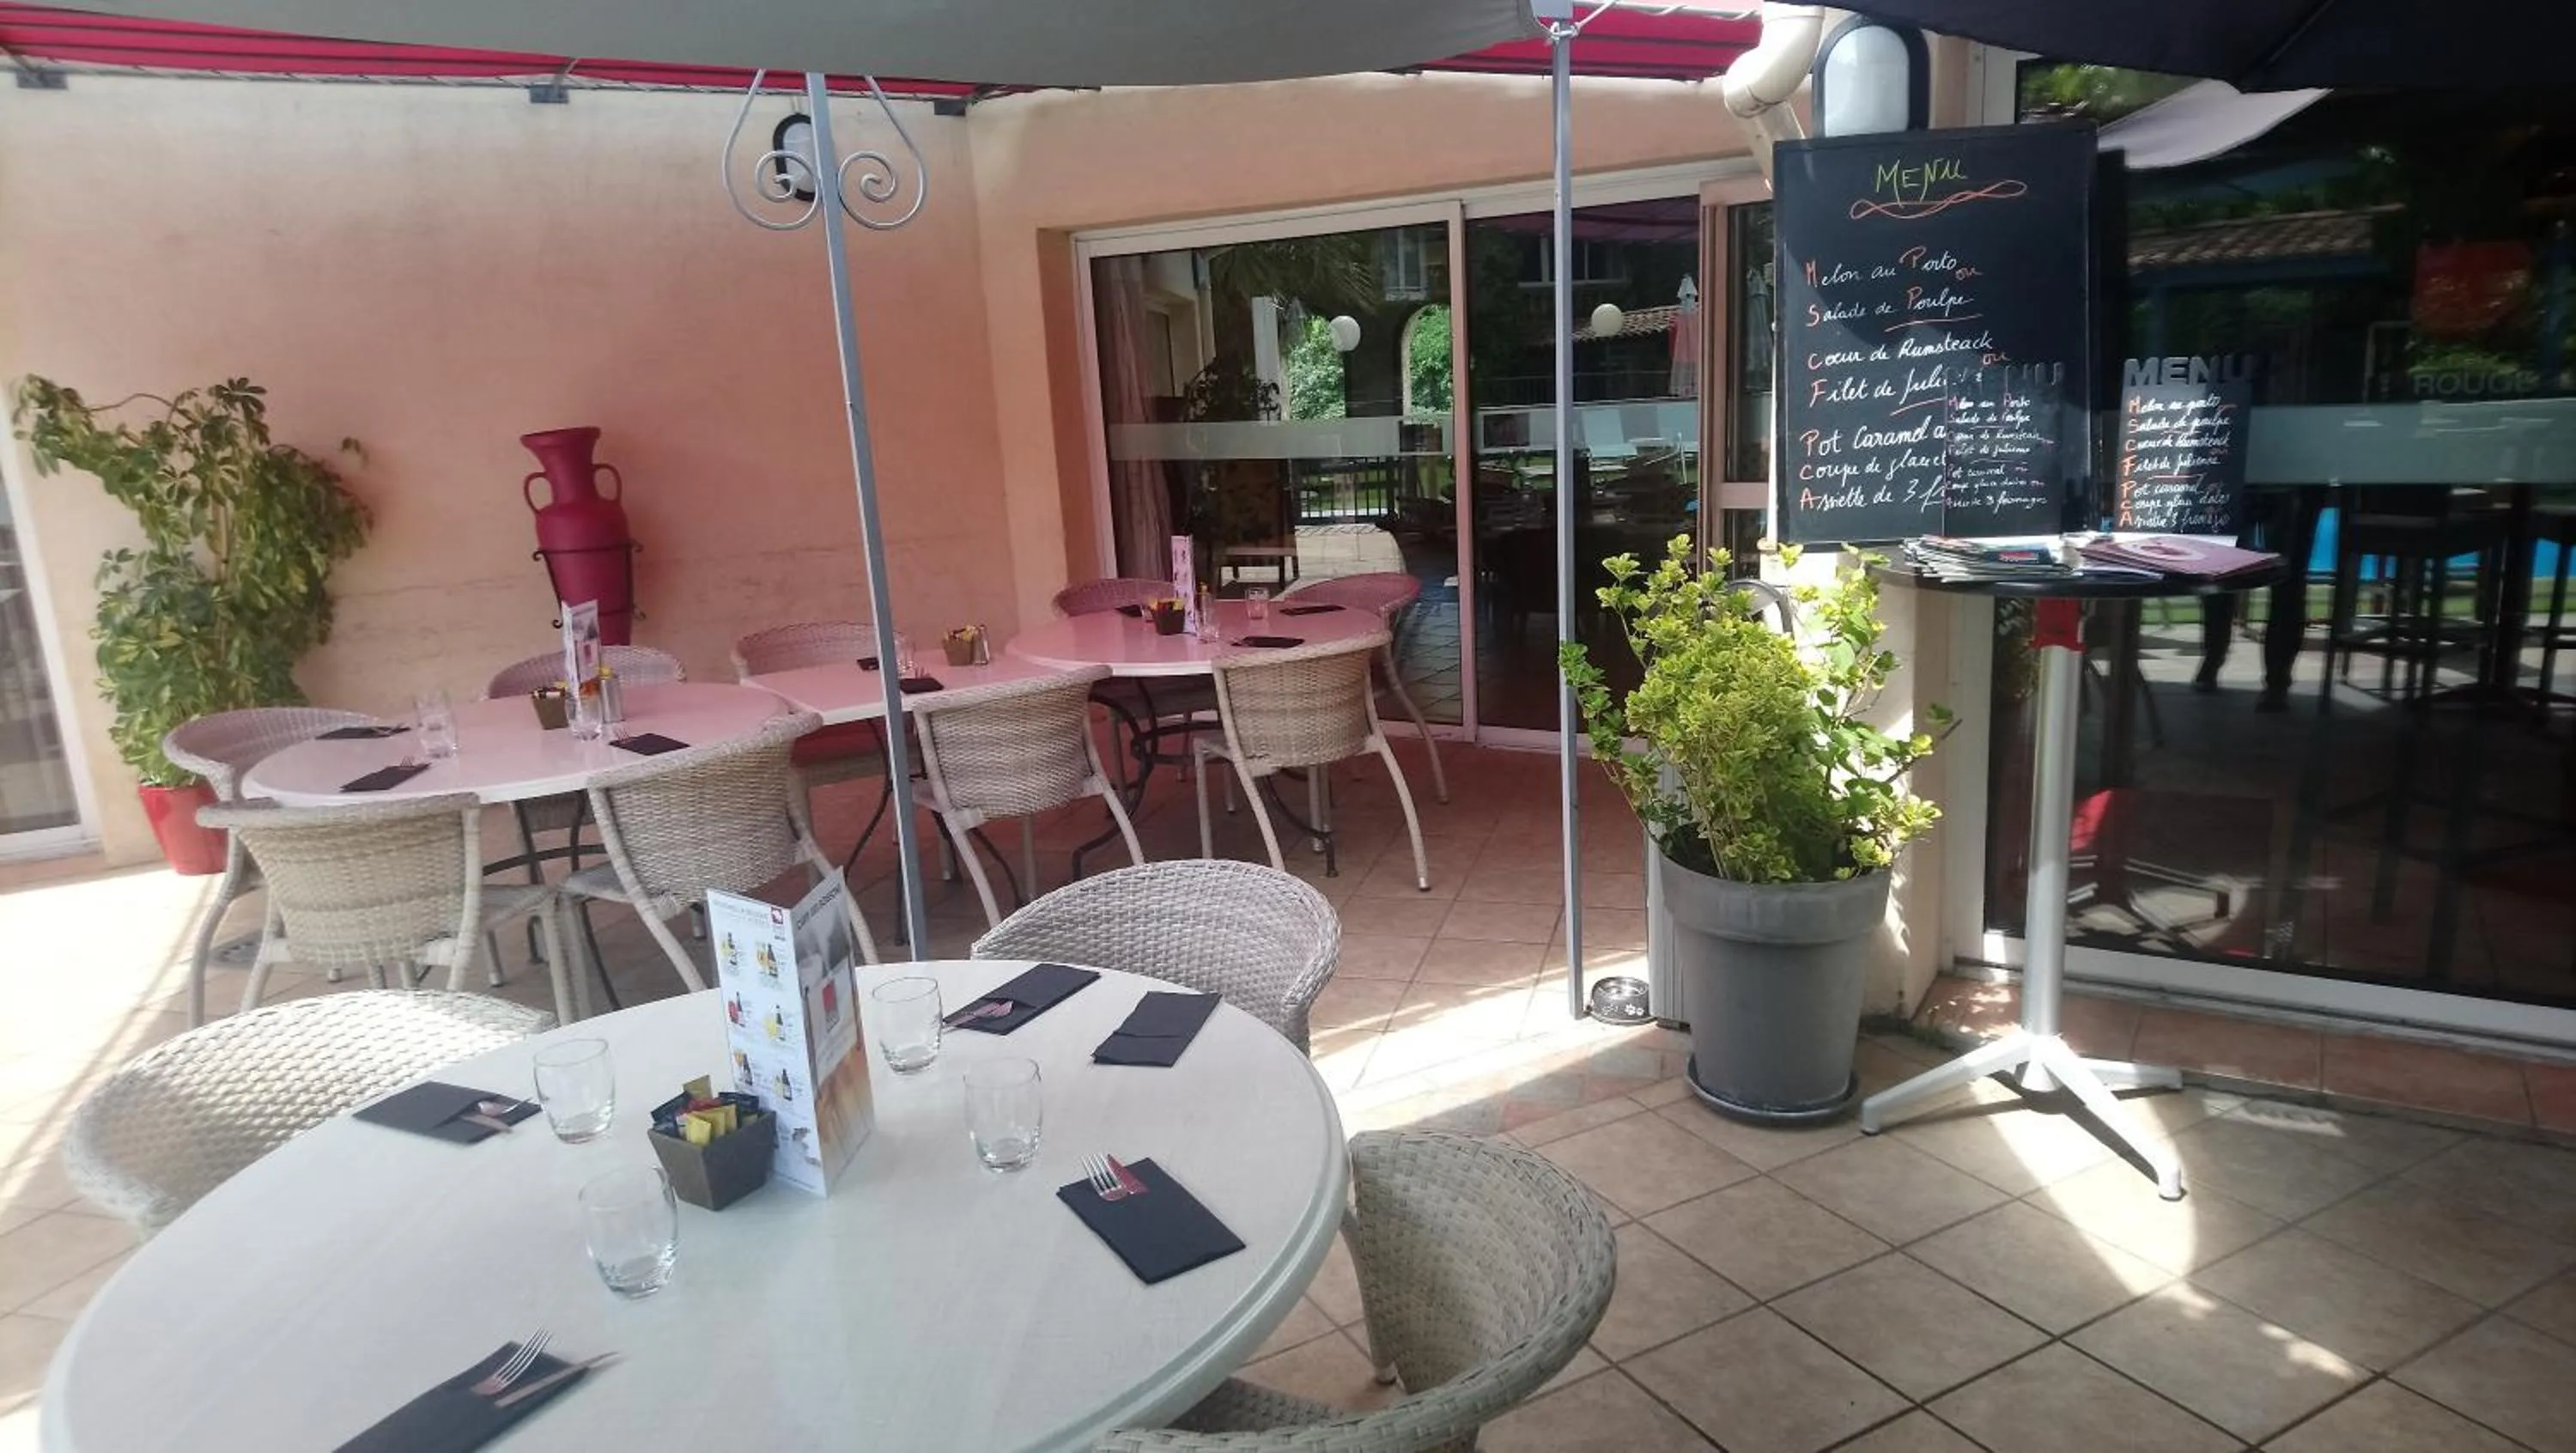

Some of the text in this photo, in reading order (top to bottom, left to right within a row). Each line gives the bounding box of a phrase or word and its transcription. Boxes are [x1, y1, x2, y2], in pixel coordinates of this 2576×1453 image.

[1876, 158, 1968, 208] MENU
[1806, 259, 1860, 288] Melon
[1871, 266, 1897, 279] au
[1899, 246, 1957, 271] Porto
[1807, 286, 1974, 327] Salade de Poulpe
[1869, 344, 1890, 360] de
[2124, 355, 2254, 386] MENU
[1806, 378, 1868, 408] Filet
[1874, 380, 1896, 397] de
[1800, 429, 1843, 456] Pot
[1800, 464, 1860, 487] Coupe
[1864, 457, 1882, 473] de
[1800, 485, 1868, 512] Assiette
[1873, 485, 1893, 504] de
[1903, 478, 1918, 502] 3
